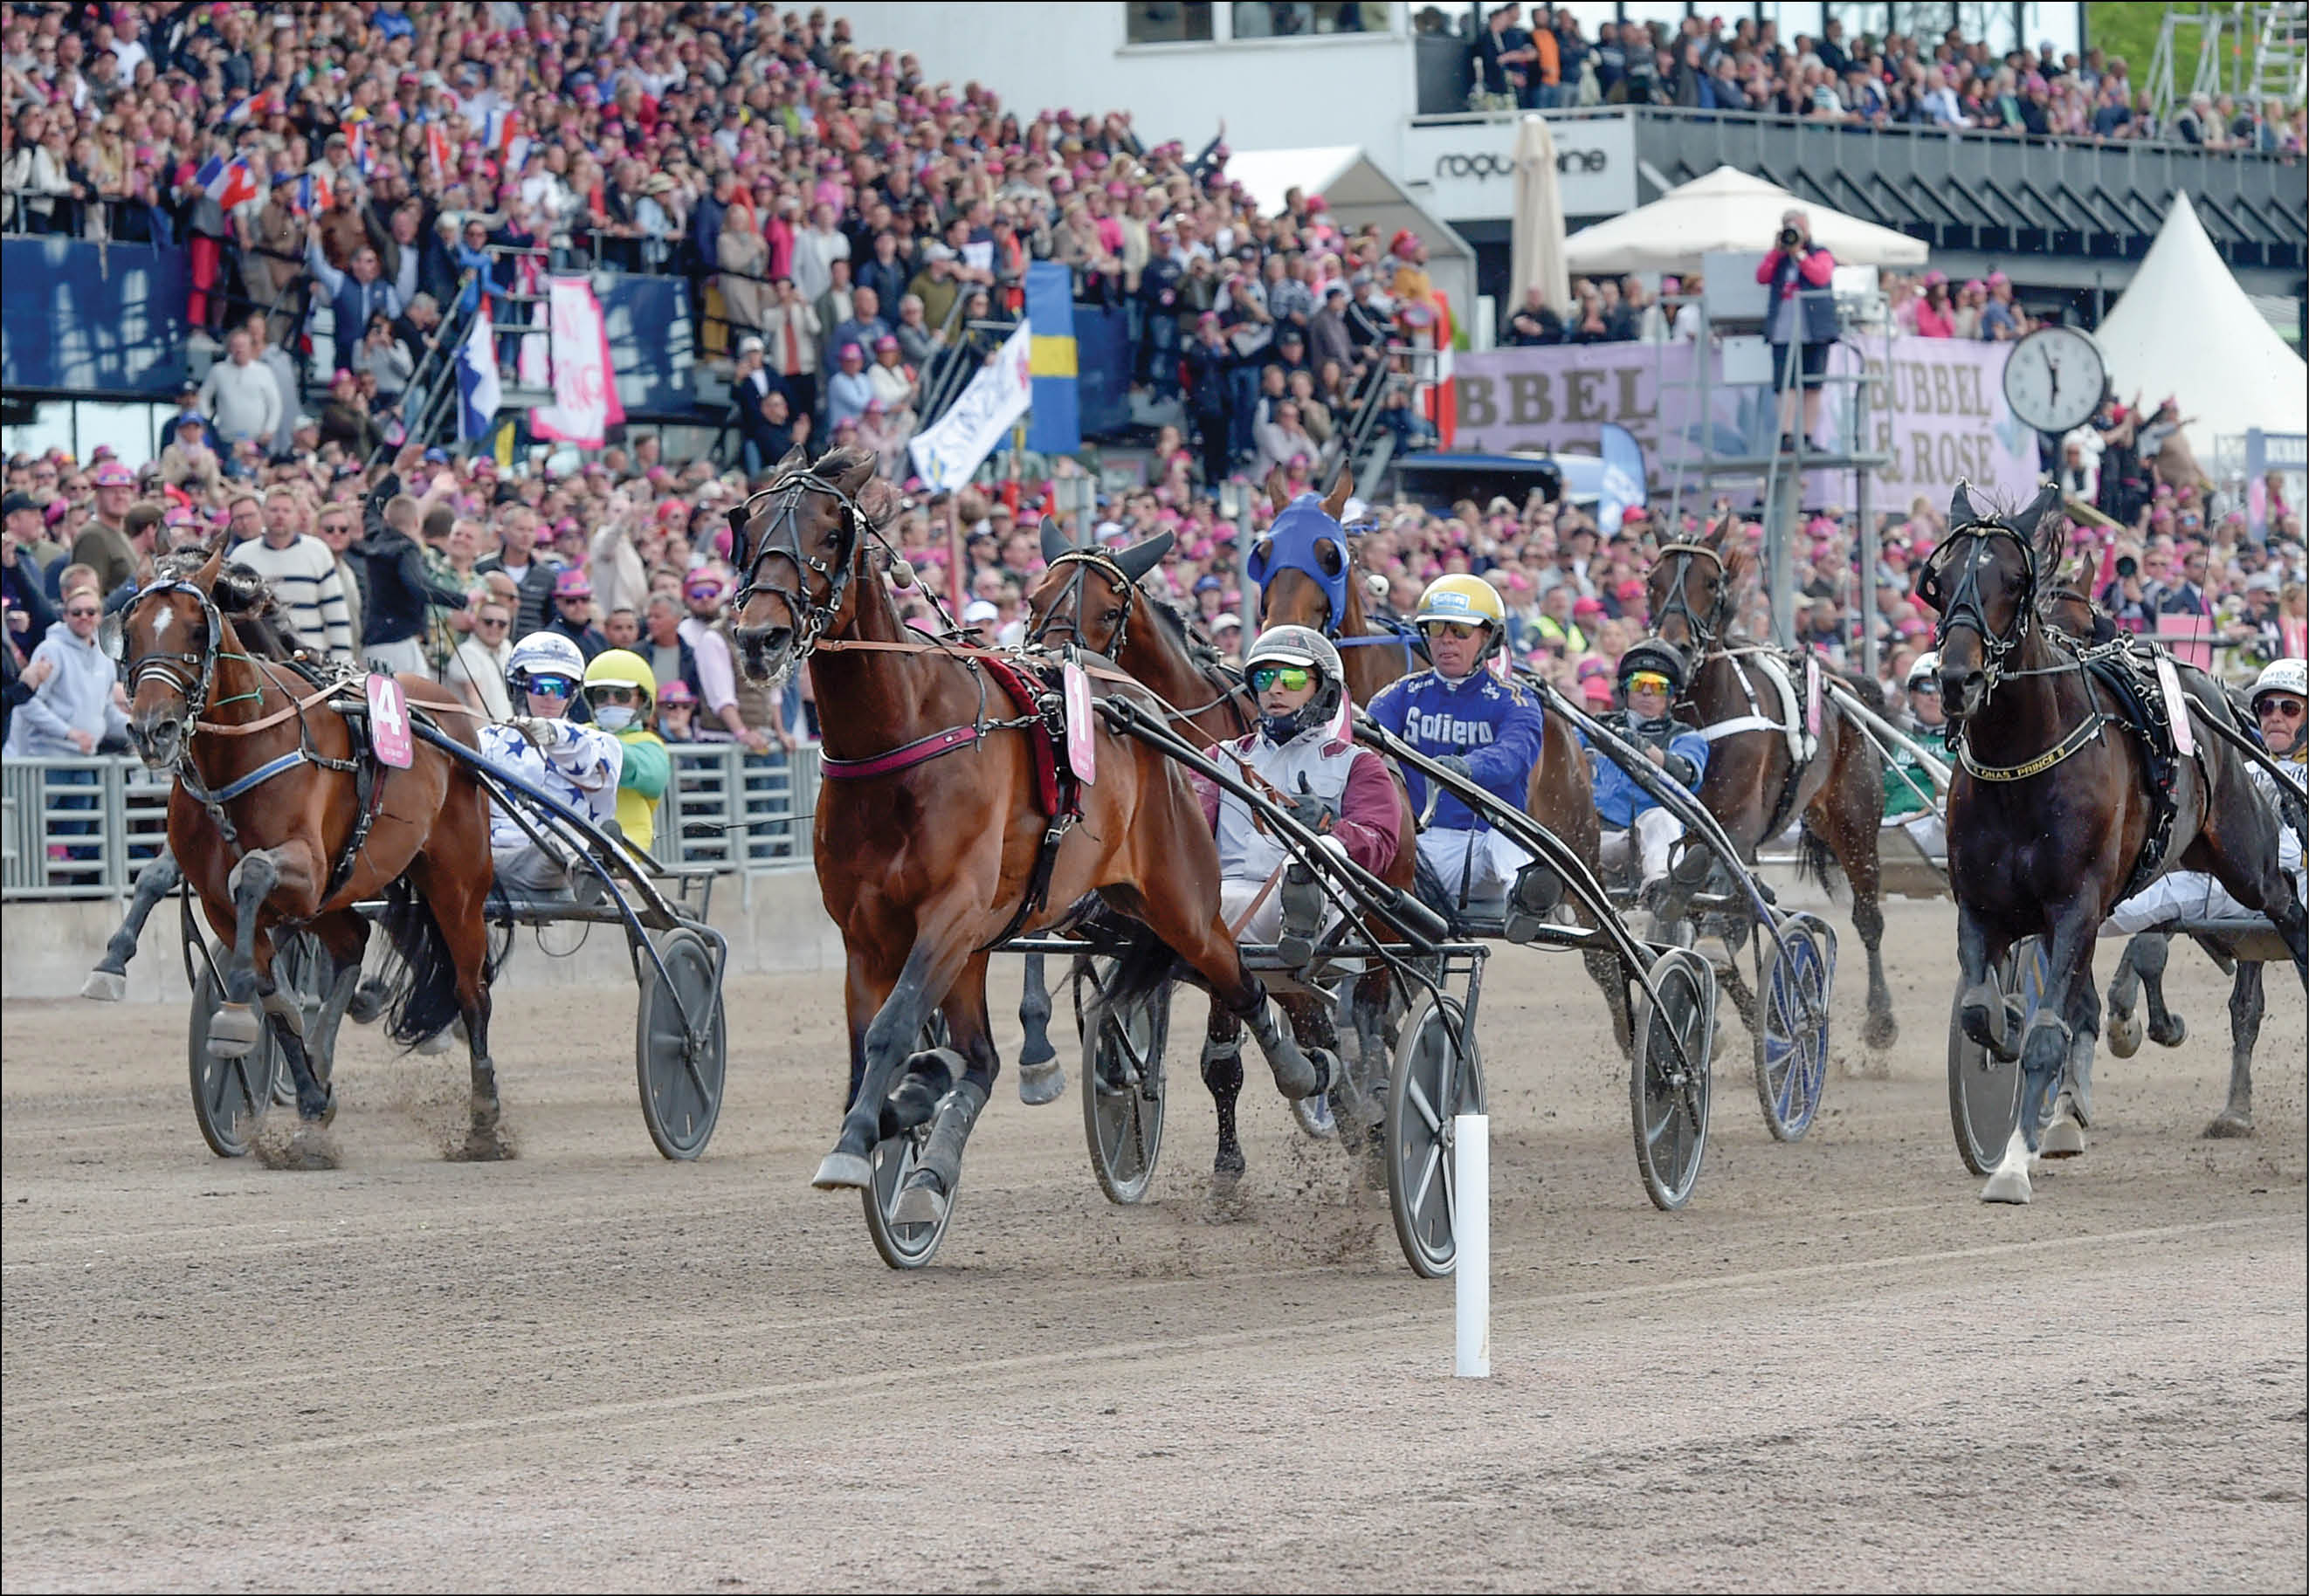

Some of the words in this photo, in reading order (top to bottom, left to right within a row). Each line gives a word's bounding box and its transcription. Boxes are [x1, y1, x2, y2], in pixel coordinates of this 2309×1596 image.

[1436, 149, 1606, 182] roquine
[1865, 359, 1992, 416] BUBBEL
[1911, 420, 1996, 486] ROSÉ
[376, 678, 402, 737] 4
[1403, 705, 1493, 746] Sofiero
